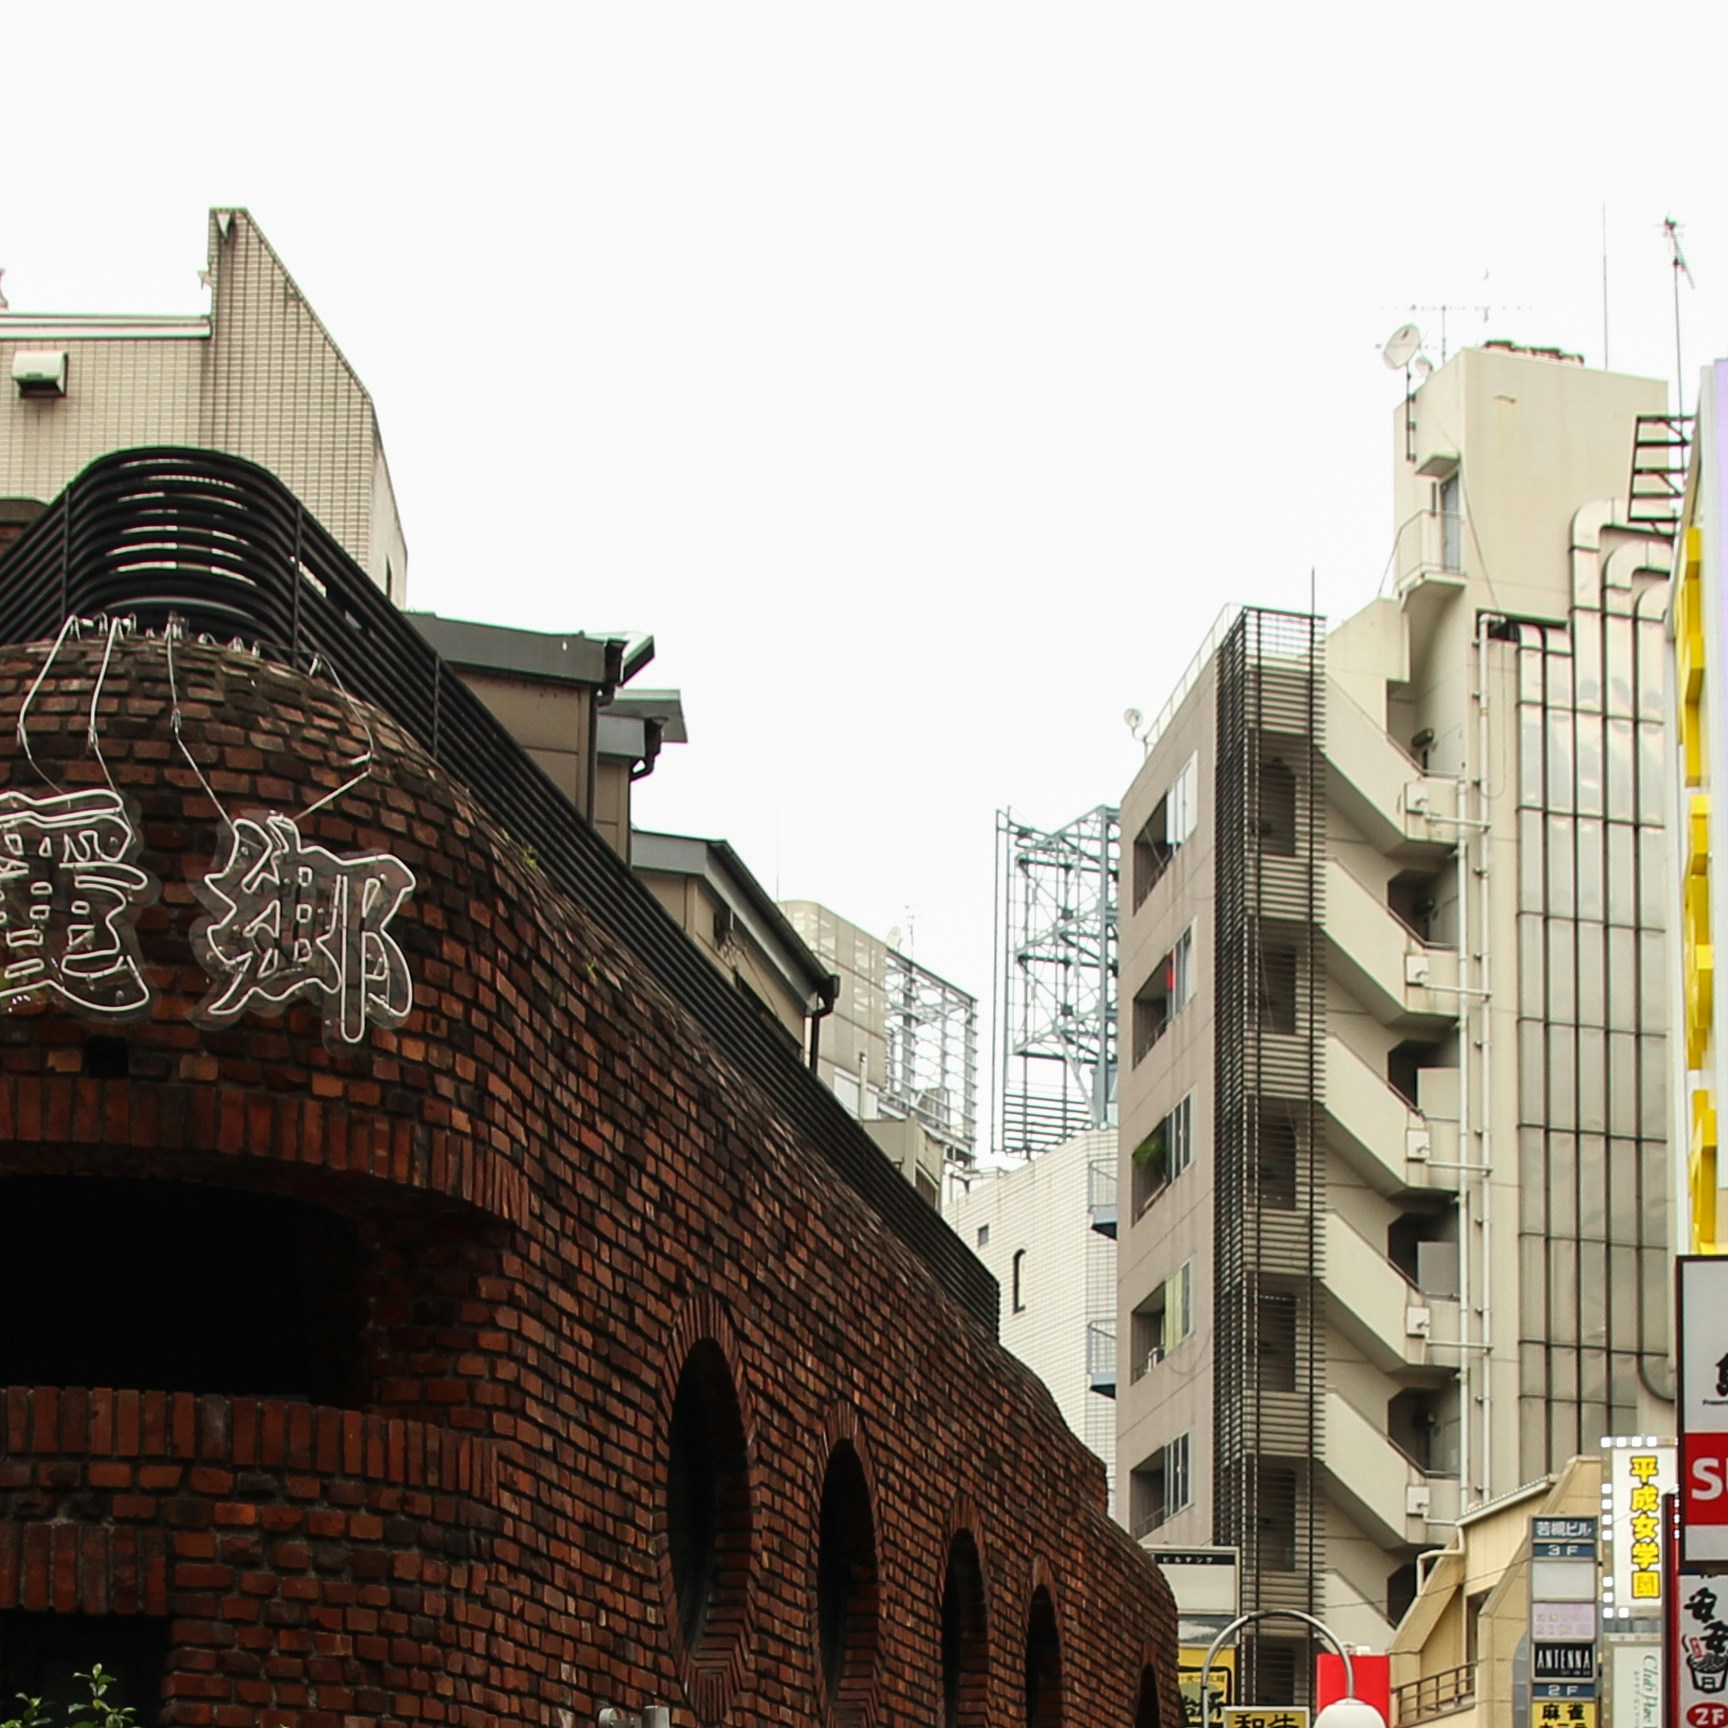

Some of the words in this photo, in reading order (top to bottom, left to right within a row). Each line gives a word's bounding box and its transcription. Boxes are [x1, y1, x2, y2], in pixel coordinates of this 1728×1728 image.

[1537, 1648, 1590, 1669] ANTENNA
[1542, 1703, 1586, 1721] 麻雀
[1694, 1706, 1725, 1726] 2F
